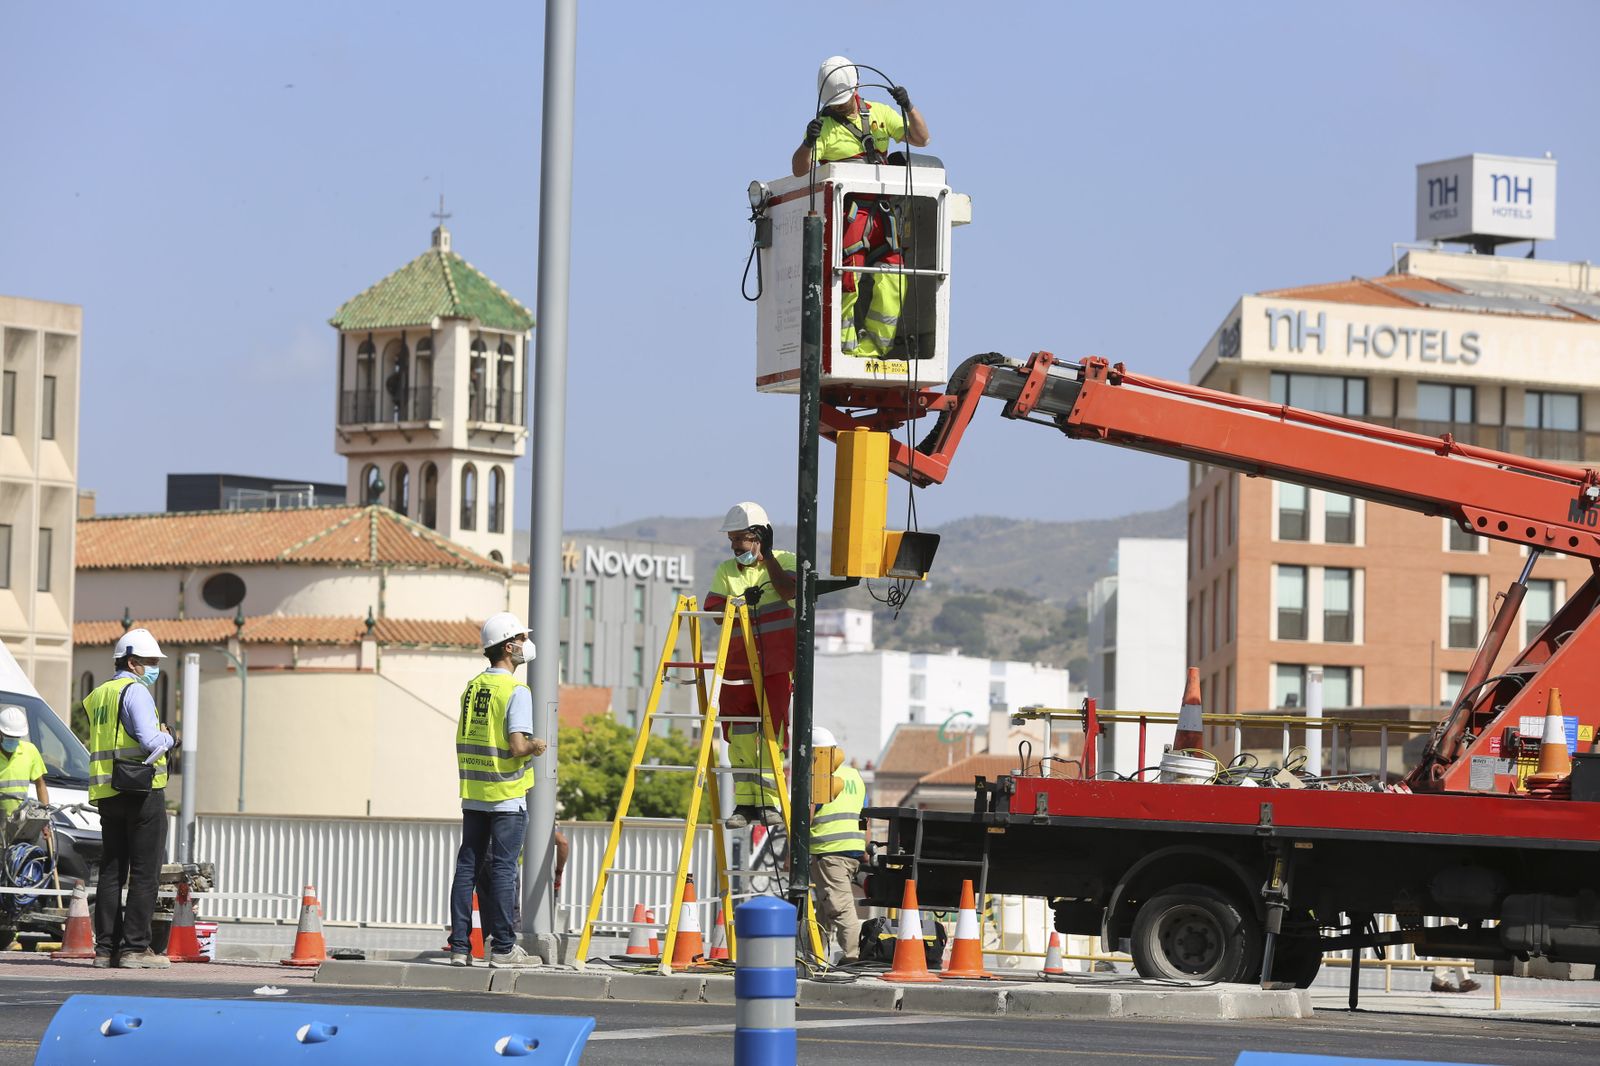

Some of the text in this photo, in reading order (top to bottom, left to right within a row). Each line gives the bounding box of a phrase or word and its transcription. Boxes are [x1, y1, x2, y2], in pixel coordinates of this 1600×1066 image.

[1428, 206, 1458, 221] HOTELS
[1492, 207, 1533, 220] HOTELS
[1347, 322, 1481, 366] HOTELS
[585, 545, 694, 582] NOVOTEL
